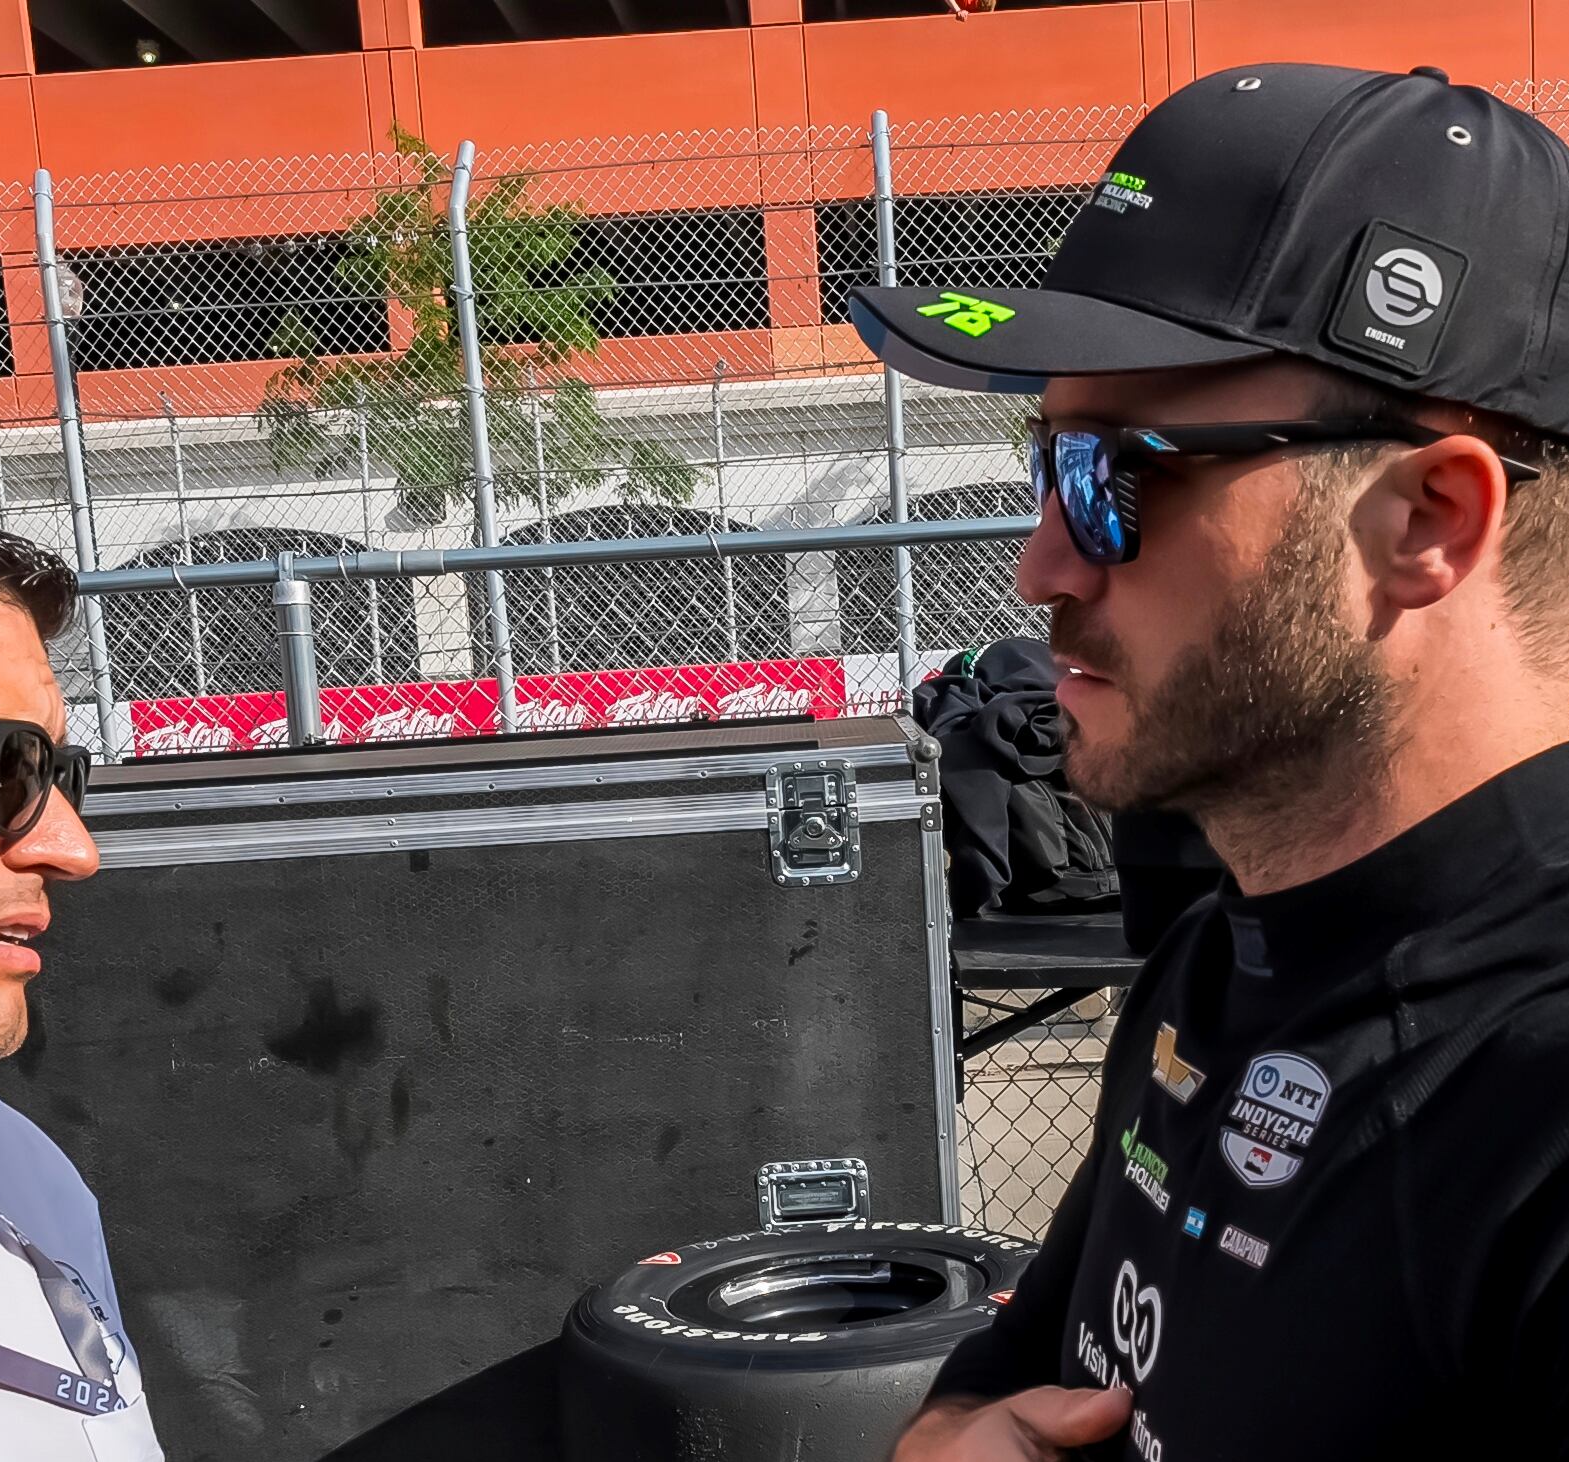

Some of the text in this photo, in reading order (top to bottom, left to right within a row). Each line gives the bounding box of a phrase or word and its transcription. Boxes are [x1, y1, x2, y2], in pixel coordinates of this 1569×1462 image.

[916, 292, 1016, 337] 78
[1279, 1079, 1323, 1110] NTT
[1232, 1099, 1314, 1145] INDYCAR
[1243, 1123, 1289, 1149] SERIES
[822, 1222, 1025, 1250] Firestone
[613, 1304, 828, 1342] Firestone
[1078, 1322, 1107, 1386] Visit
